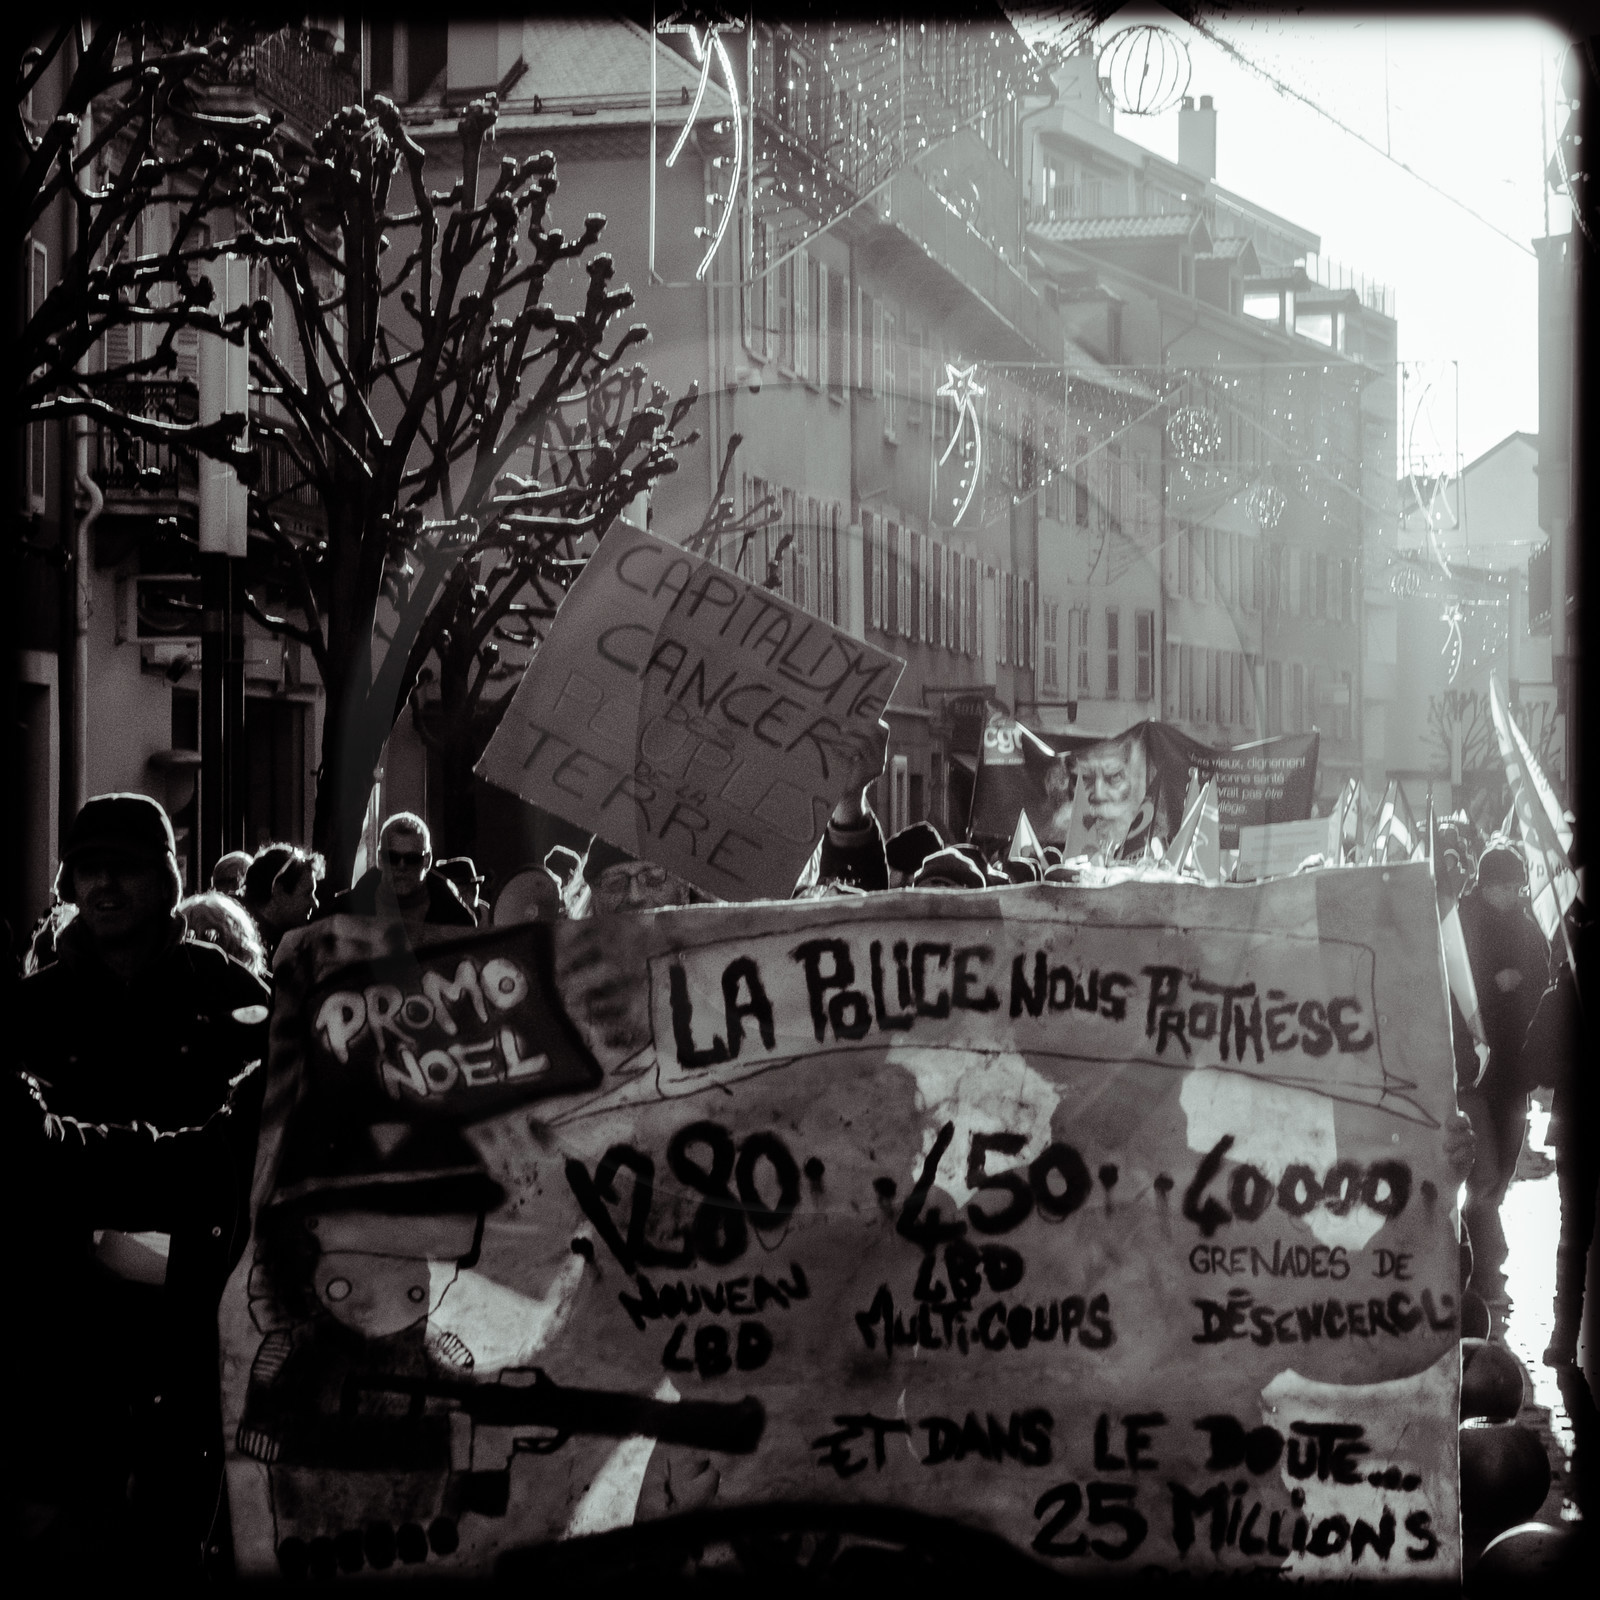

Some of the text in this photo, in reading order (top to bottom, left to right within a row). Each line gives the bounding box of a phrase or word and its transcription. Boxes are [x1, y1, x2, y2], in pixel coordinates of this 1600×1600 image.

[596, 622, 842, 779] CANCER
[523, 720, 763, 884] TERRE
[1246, 756, 1306, 771] dignement
[315, 957, 529, 1064] PROMO
[668, 955, 778, 1070] LA
[791, 937, 1001, 1042] POLICE
[1009, 952, 1143, 1020] NOUS
[381, 1025, 553, 1099] NOEL
[896, 1119, 1094, 1246] 450
[913, 1240, 1026, 1302] LBD
[1188, 1238, 1415, 1281] GRENADES DE
[660, 1319, 775, 1380] LBD
[810, 1412, 914, 1479] ET
[917, 1408, 1054, 1468] DANS
[1093, 1410, 1168, 1472] LE
[1032, 1480, 1148, 1561] 25
